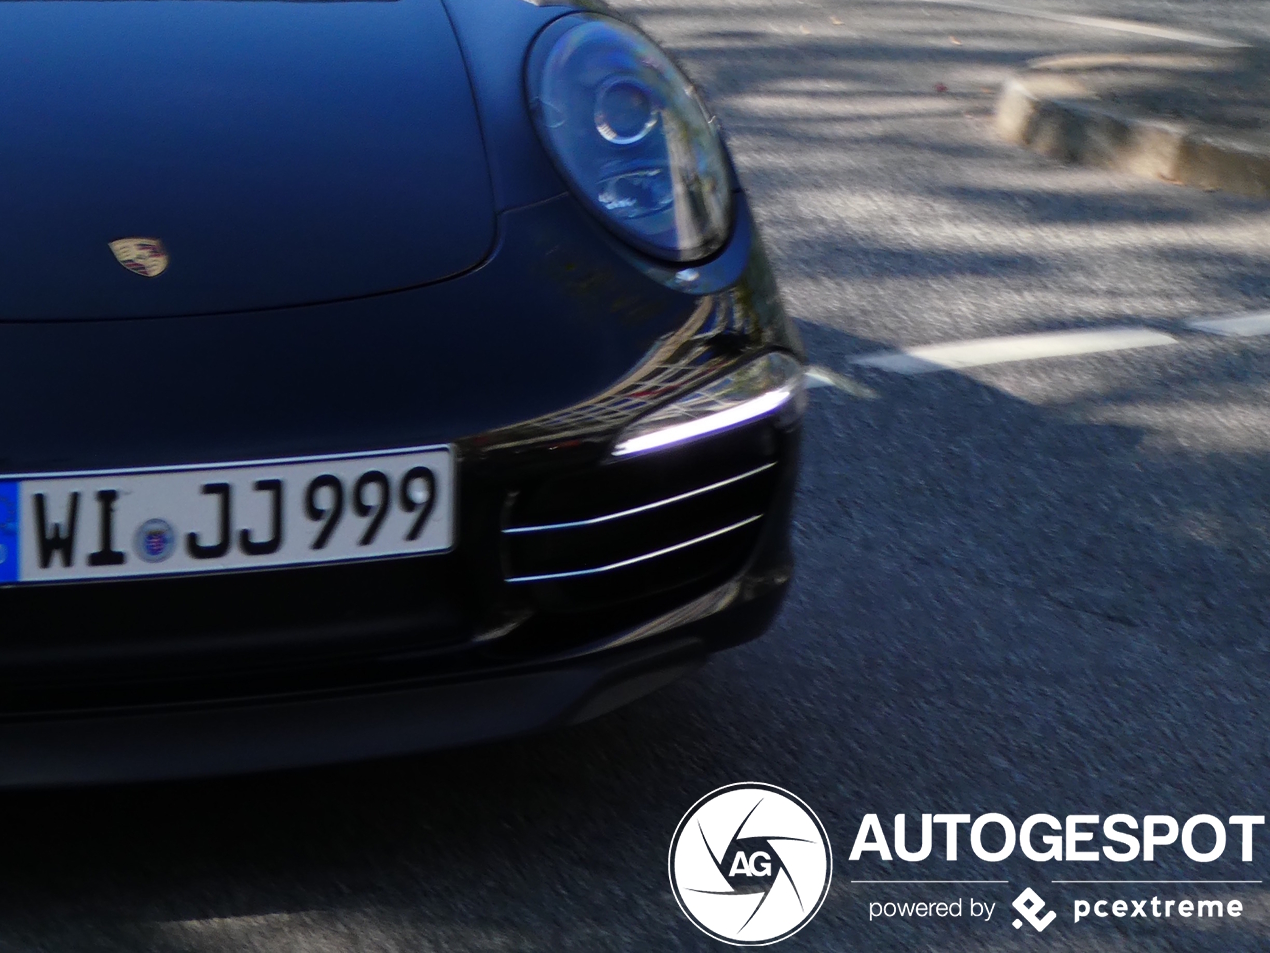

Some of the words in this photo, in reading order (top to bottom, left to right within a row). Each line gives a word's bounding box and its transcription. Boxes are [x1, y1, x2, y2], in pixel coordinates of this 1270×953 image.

[33, 488, 125, 568] WI
[186, 480, 283, 559] JJ
[305, 466, 438, 550] 999
